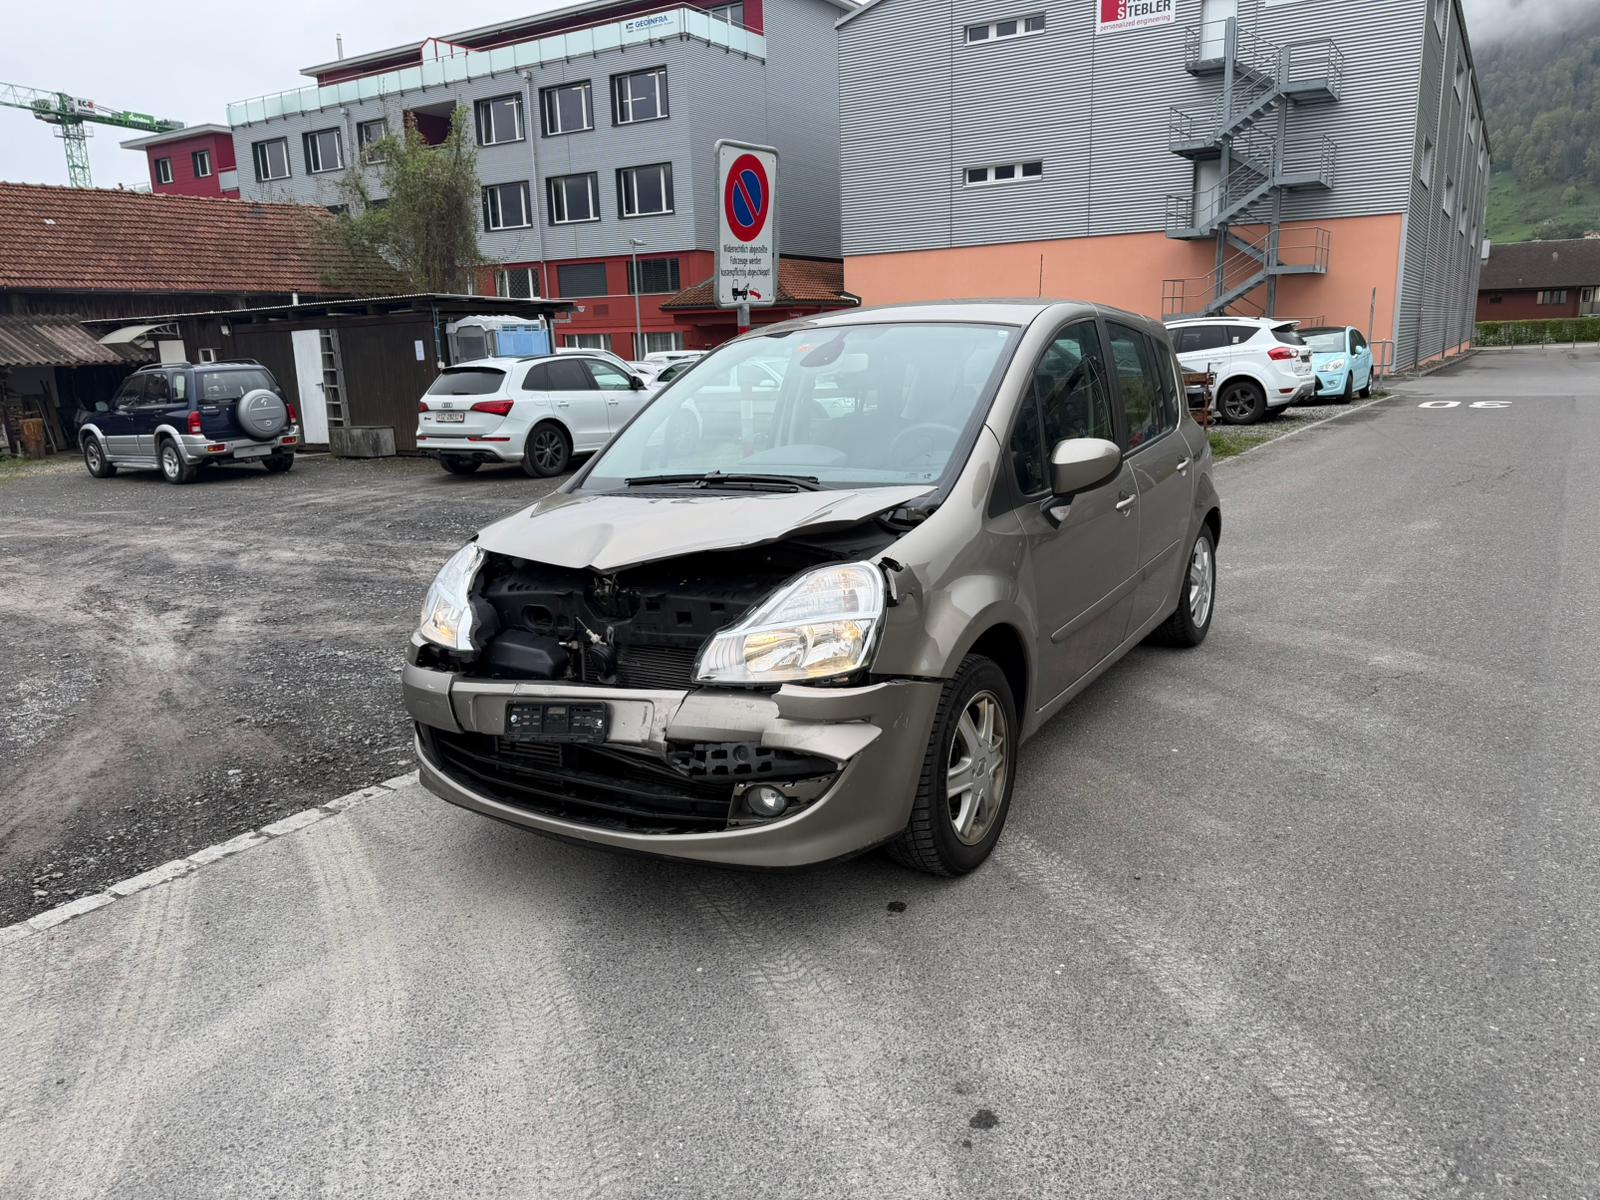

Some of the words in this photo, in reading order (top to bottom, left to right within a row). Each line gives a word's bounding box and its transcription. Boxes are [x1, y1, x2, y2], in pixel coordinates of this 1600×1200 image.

[1117, 0, 1171, 19] STEBLER
[635, 15, 668, 28] GEOINFRA
[1100, 20, 1136, 31] personalized
[1137, 15, 1171, 26] engineering
[723, 244, 749, 253] Widerrechtlich
[749, 245, 768, 255] abgestellte
[730, 256, 748, 267] Fahrzeuge
[749, 257, 762, 265] werden
[720, 267, 747, 278] kostenpflichtig
